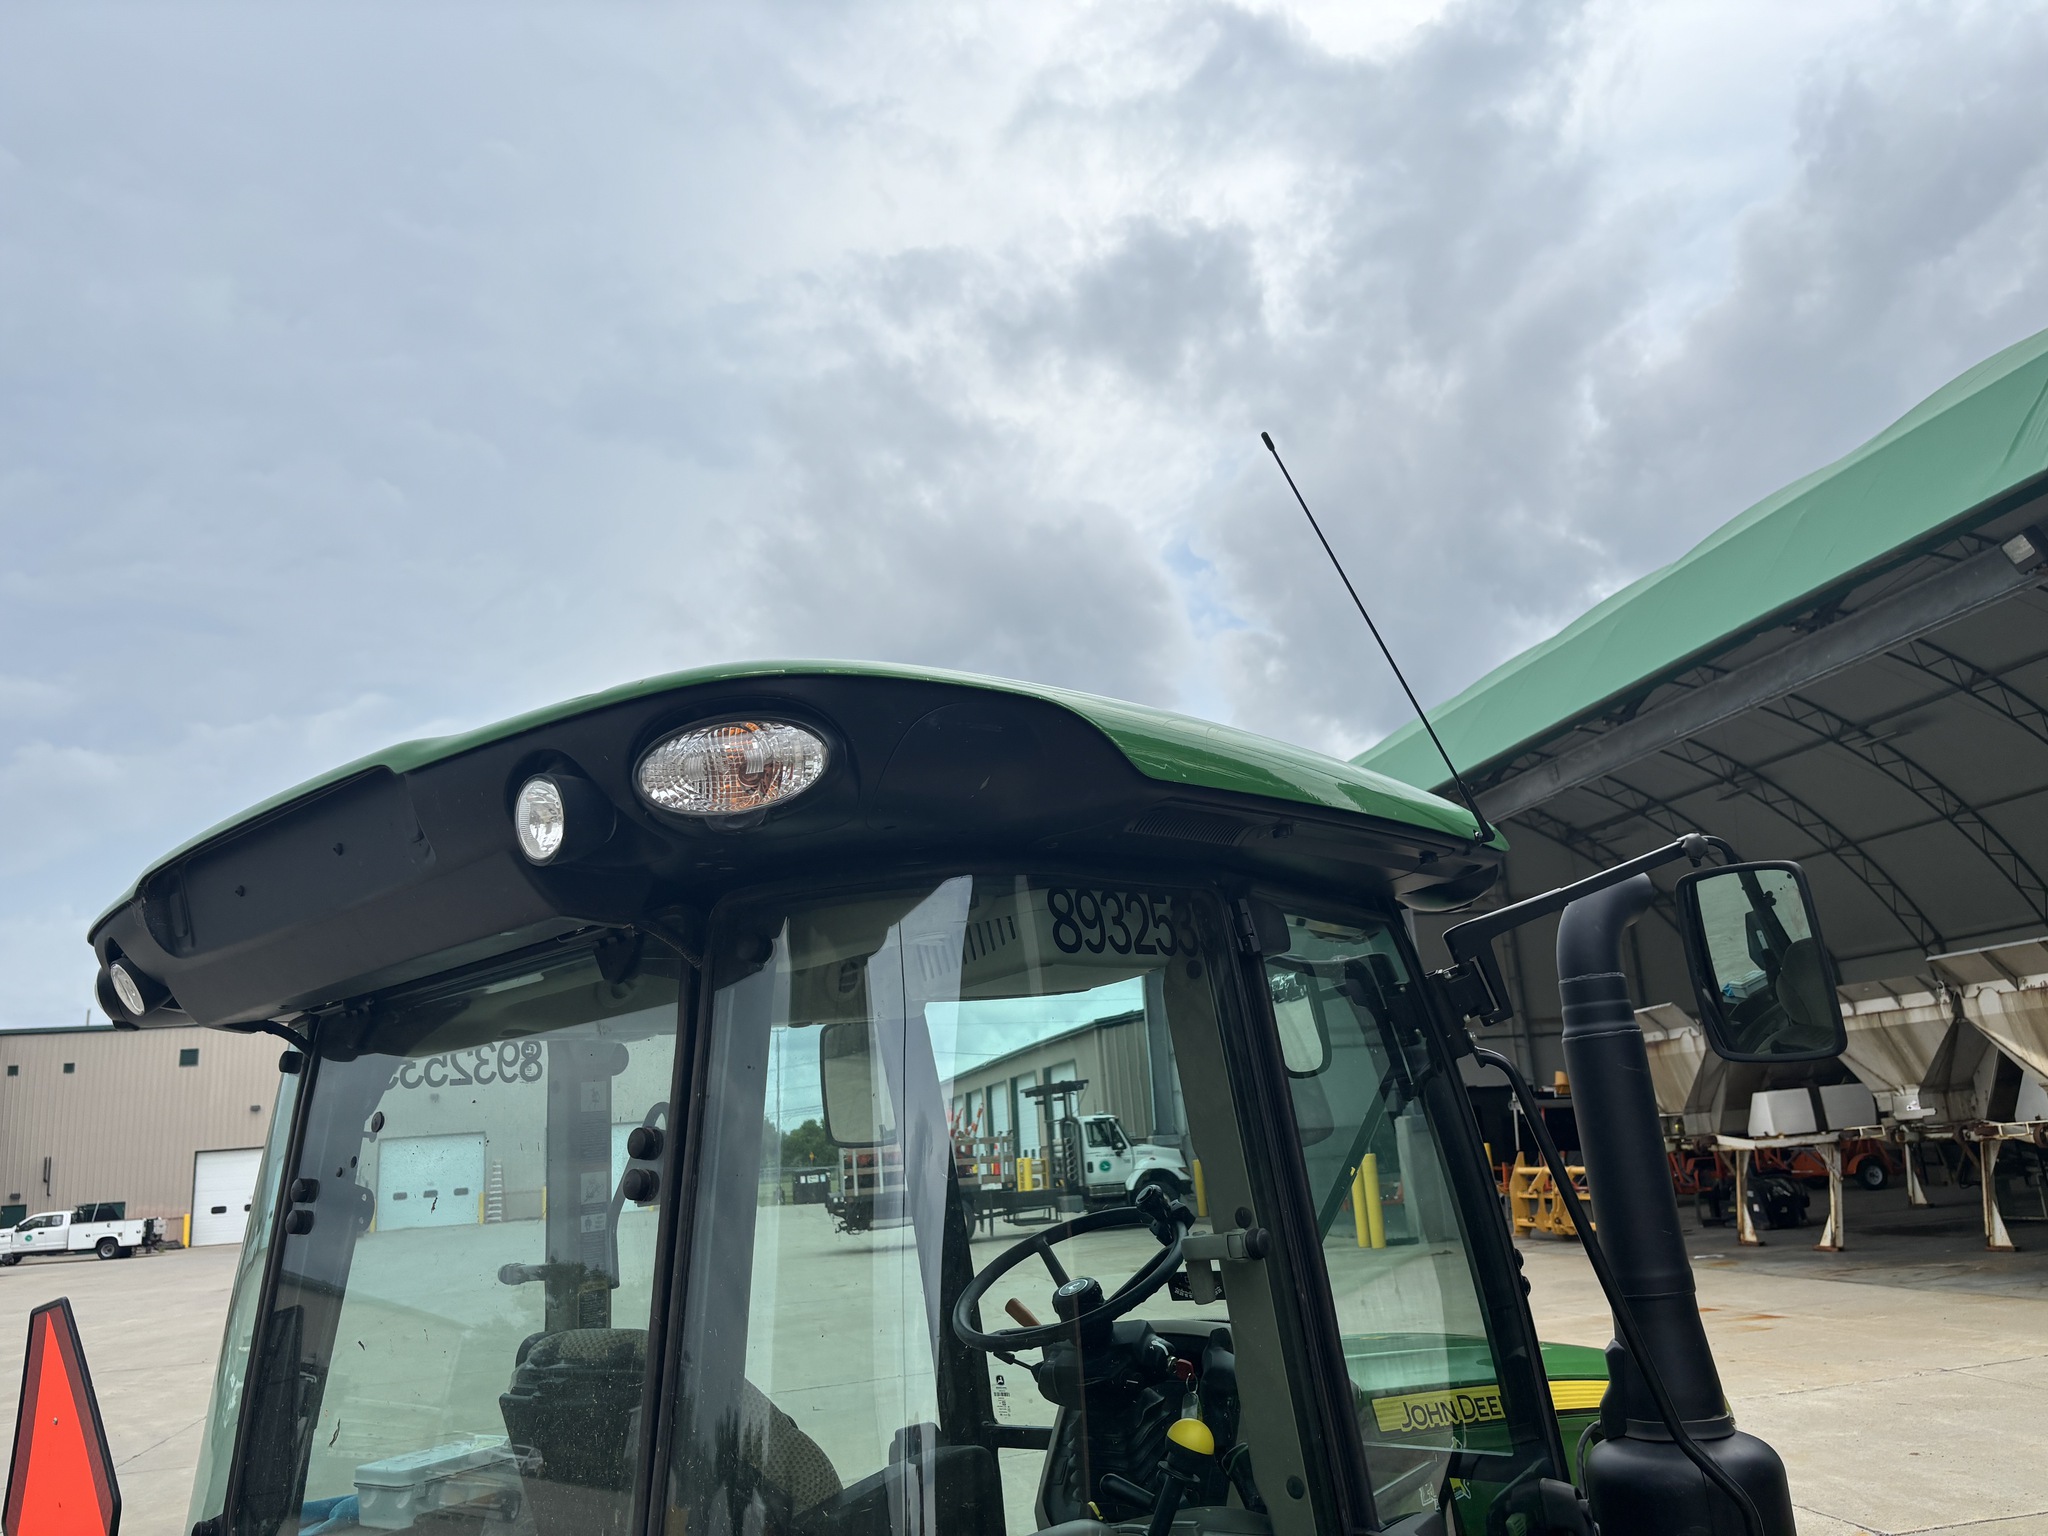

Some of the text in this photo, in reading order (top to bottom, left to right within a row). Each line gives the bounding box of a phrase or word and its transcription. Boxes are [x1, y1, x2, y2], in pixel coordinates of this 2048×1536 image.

[1047, 887, 1212, 957] 893253
[1402, 1395, 1502, 1429] JOHN DEE
